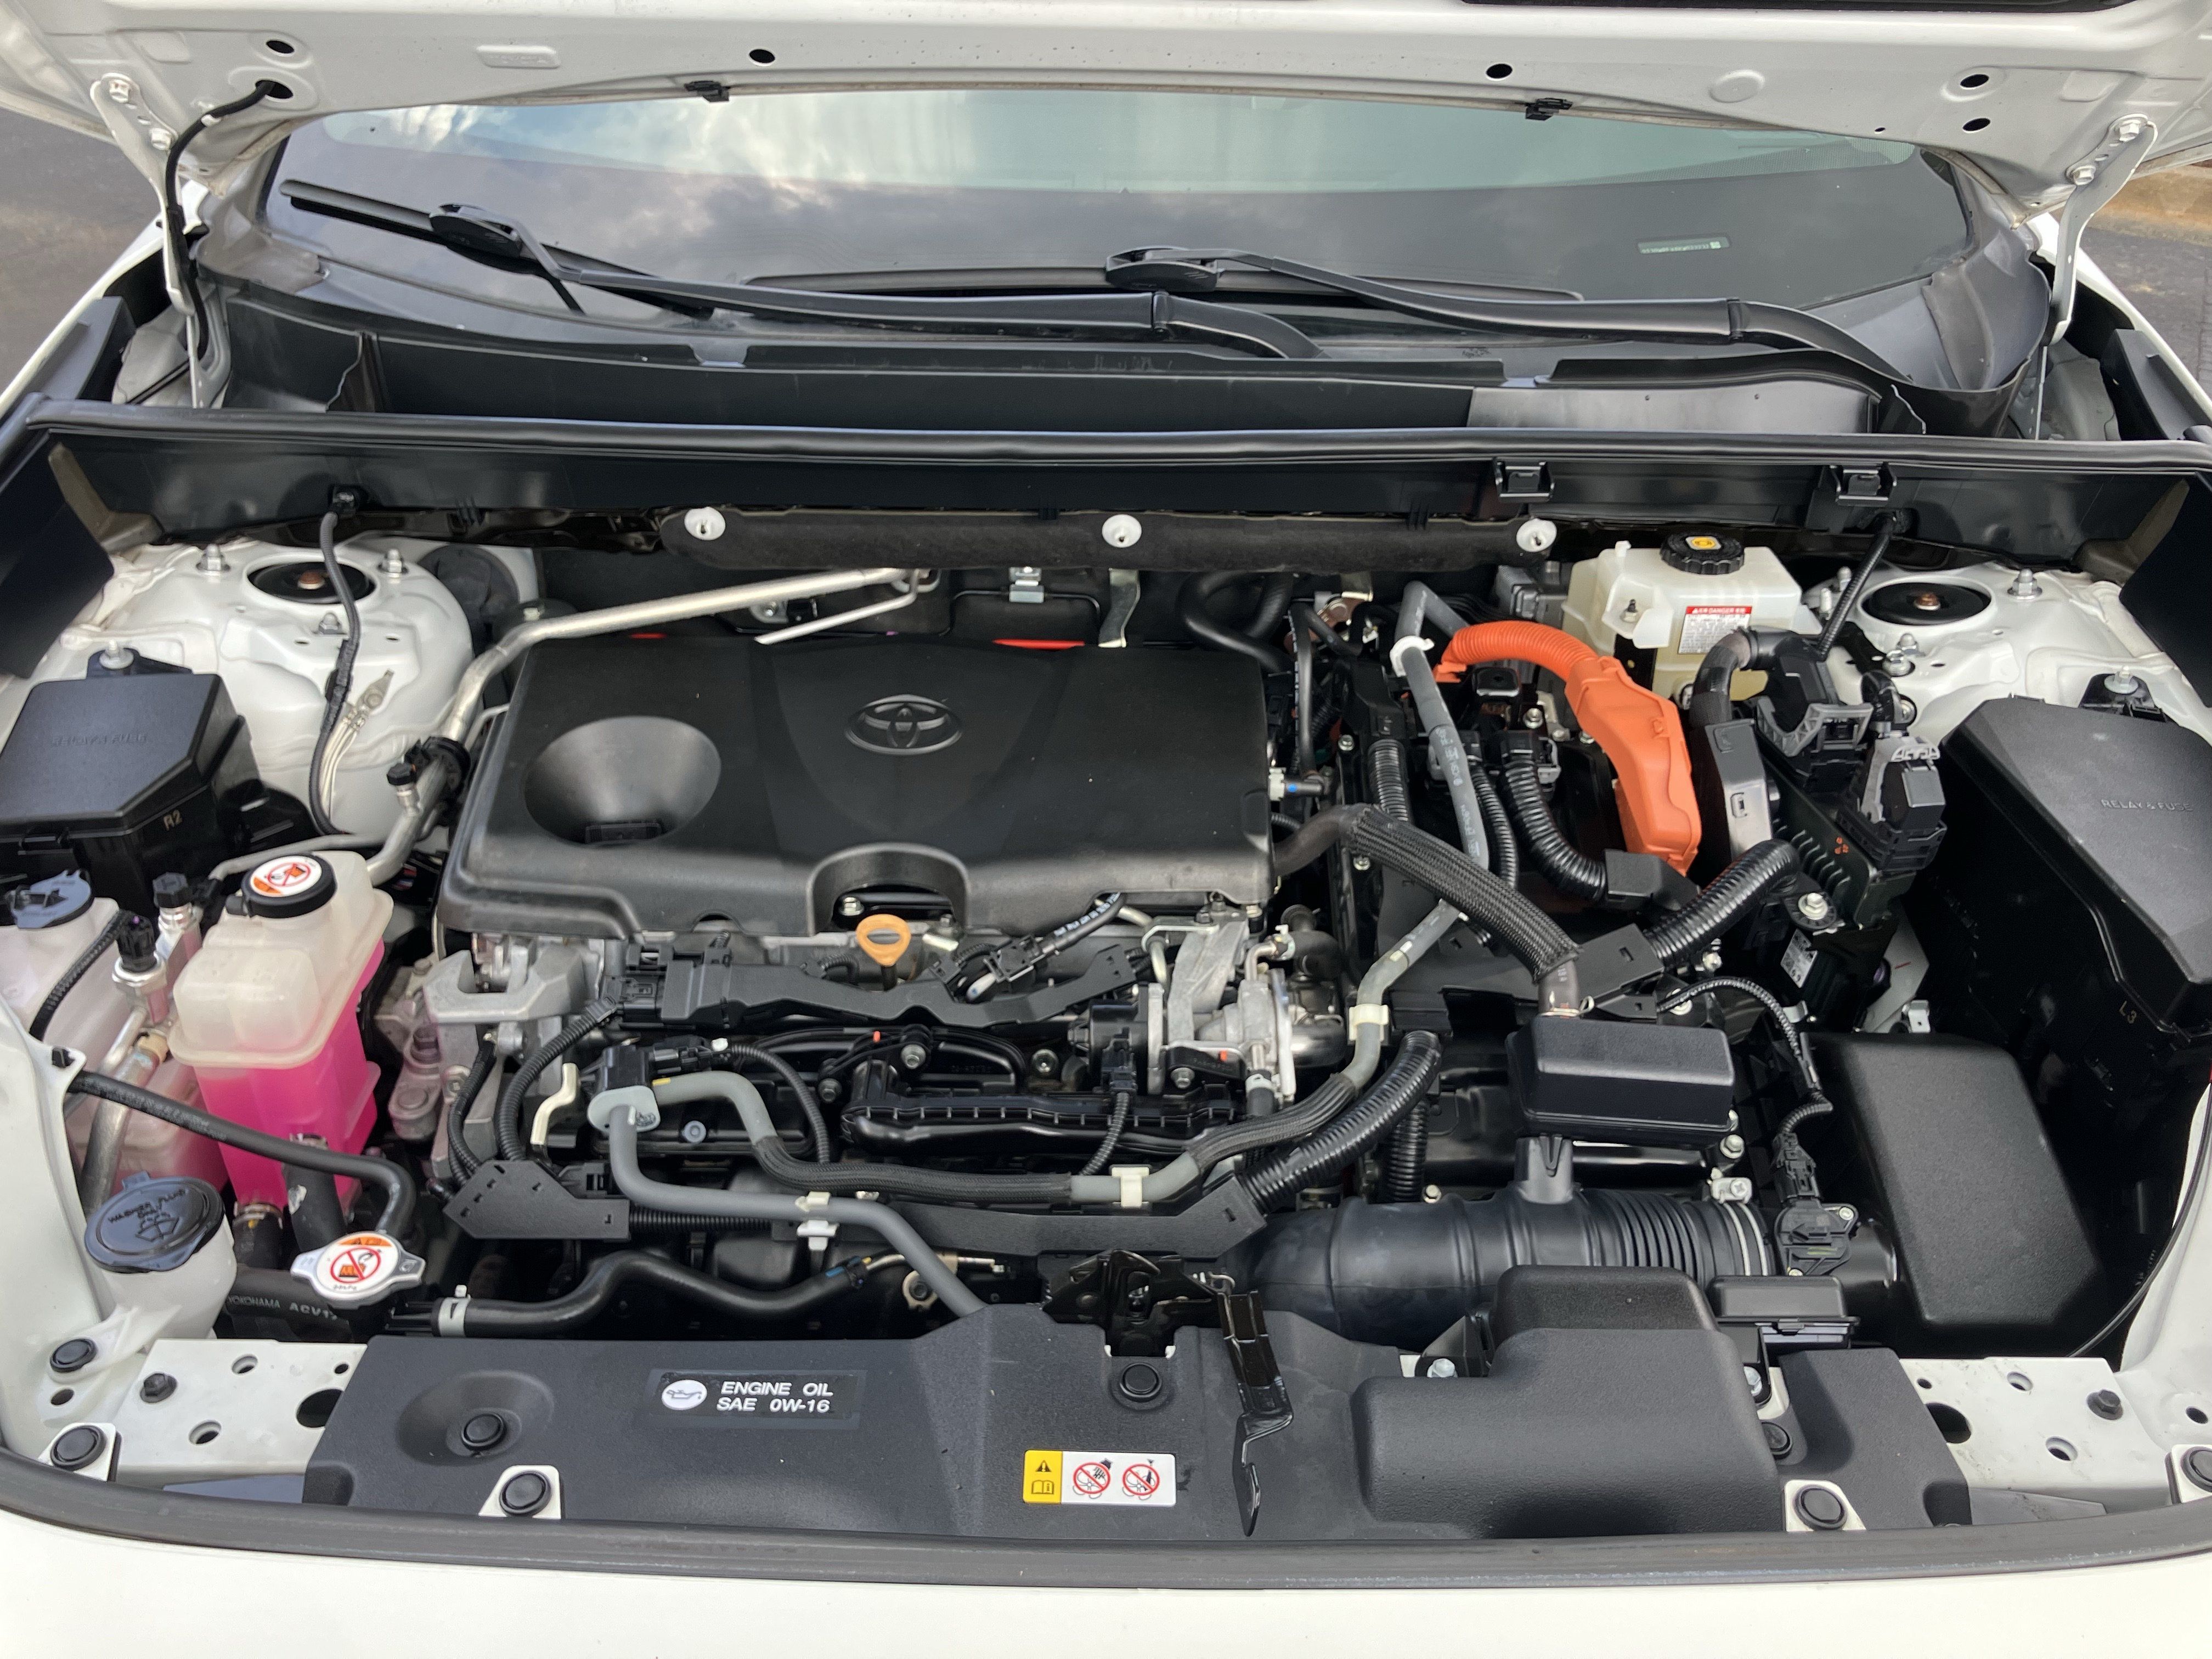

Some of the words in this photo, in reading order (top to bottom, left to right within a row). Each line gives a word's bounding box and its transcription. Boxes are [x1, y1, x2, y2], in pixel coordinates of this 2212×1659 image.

[2101, 799, 2143, 809] RELAY
[2157, 802, 2193, 812] FUSE
[163, 810, 182, 831] R2
[2119, 1000, 2137, 1024] L3
[227, 1294, 281, 1309] YOKOHAMA
[720, 1381, 792, 1396] ENGINE
[802, 1382, 834, 1397] OIL
[716, 1397, 758, 1412] SAE
[769, 1398, 831, 1414] 0W-16
